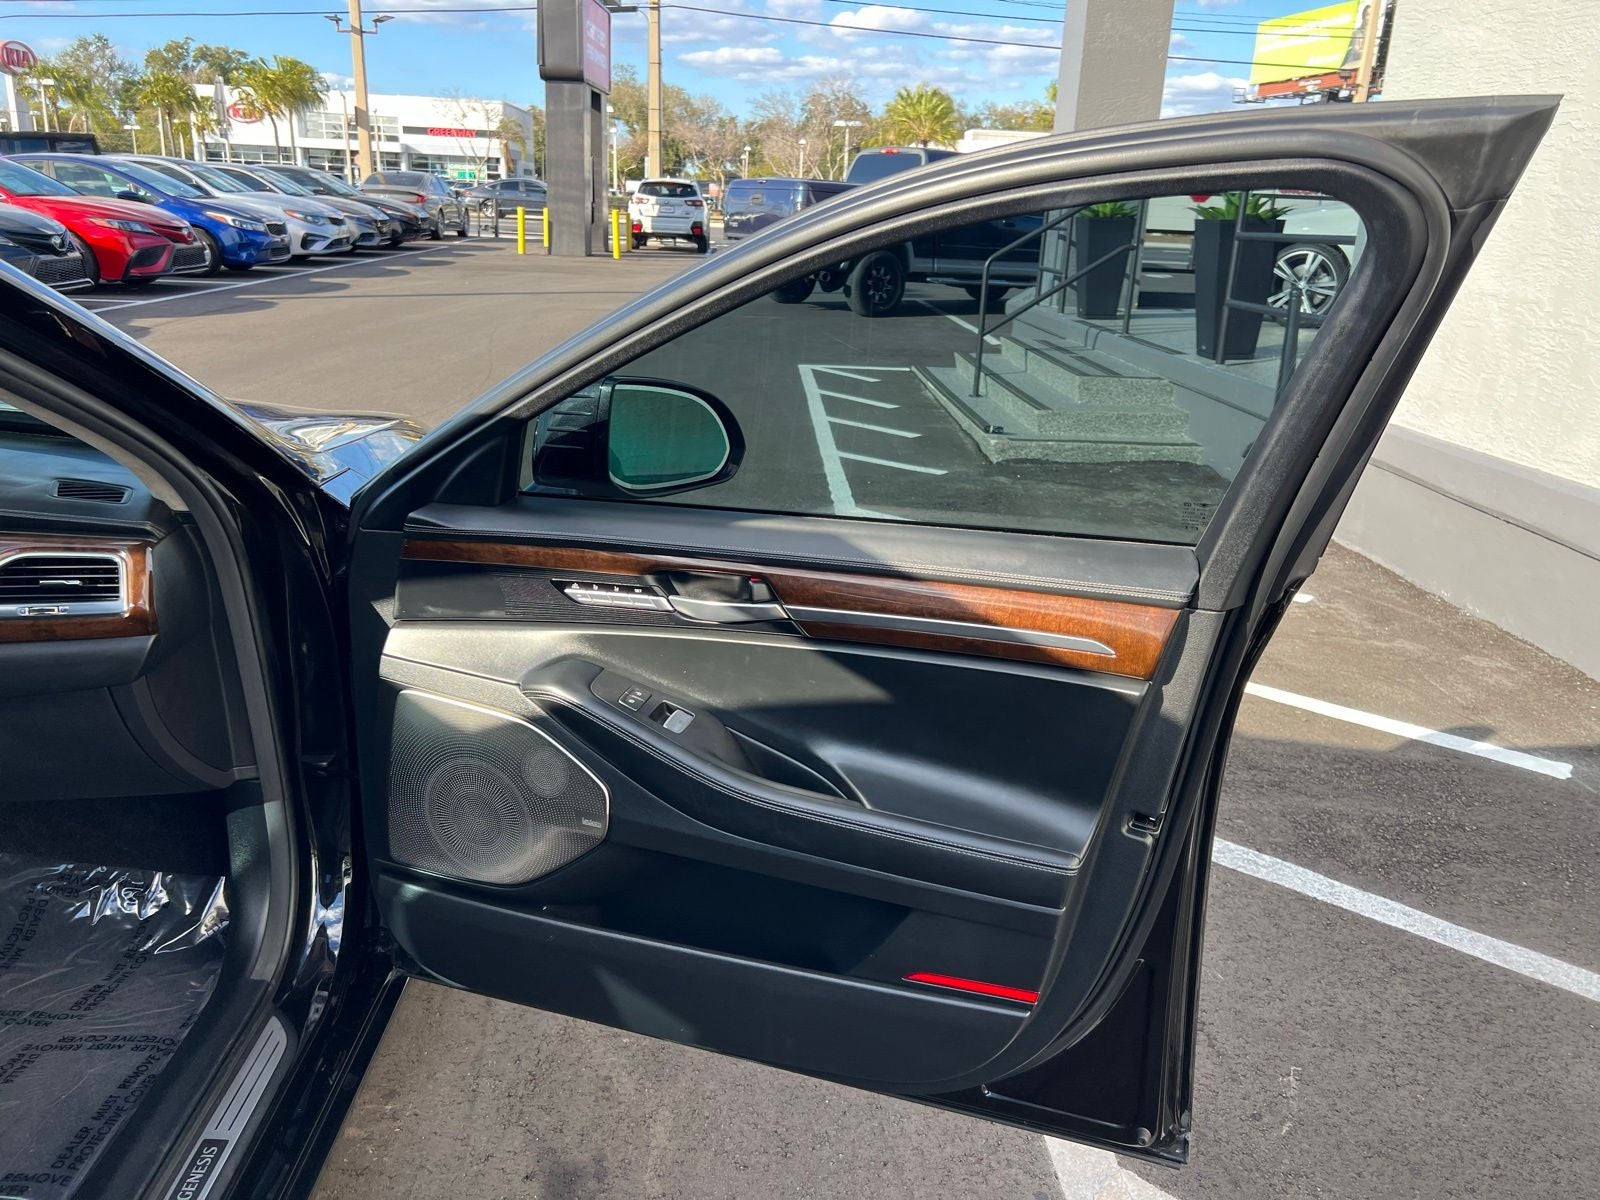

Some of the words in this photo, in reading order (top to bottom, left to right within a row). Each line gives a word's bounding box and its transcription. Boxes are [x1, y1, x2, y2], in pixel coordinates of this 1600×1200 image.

[4, 47, 31, 68] KIA
[428, 127, 477, 138] GREENWAY
[0, 897, 35, 962] PROTECTIV
[51, 1126, 93, 1169] DEALER
[91, 1094, 120, 1121] MUST
[117, 1053, 160, 1089] REMOVE
[67, 1105, 129, 1170] PROTECTIVE
[123, 1073, 157, 1104] COVER
[176, 1145, 218, 1200] GENESIS
